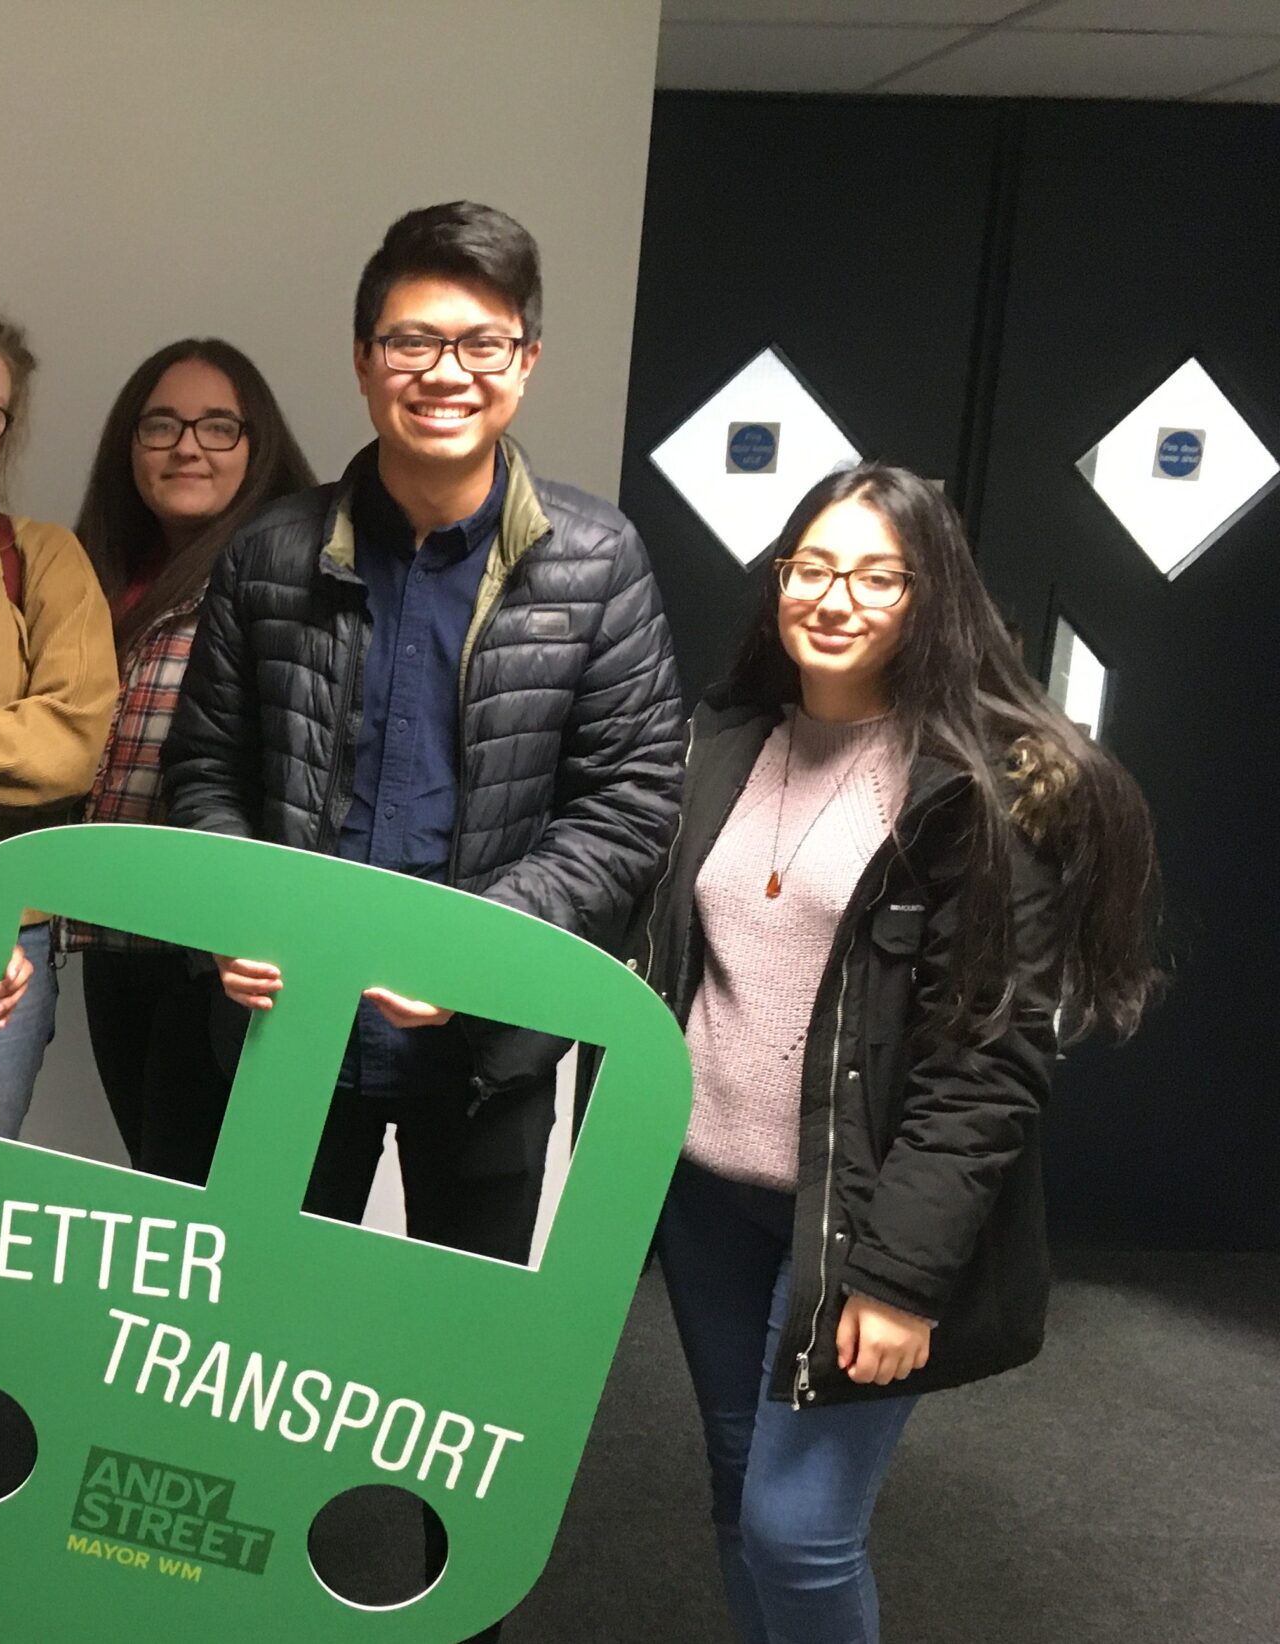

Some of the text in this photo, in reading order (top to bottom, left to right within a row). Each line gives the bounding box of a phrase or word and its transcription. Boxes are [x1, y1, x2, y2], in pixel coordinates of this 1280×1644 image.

[103, 1308, 524, 1499] TRANSPORT
[86, 1456, 226, 1517] ANDY
[66, 1535, 202, 1582] MAYOR WM
[78, 1492, 265, 1566] STREET
